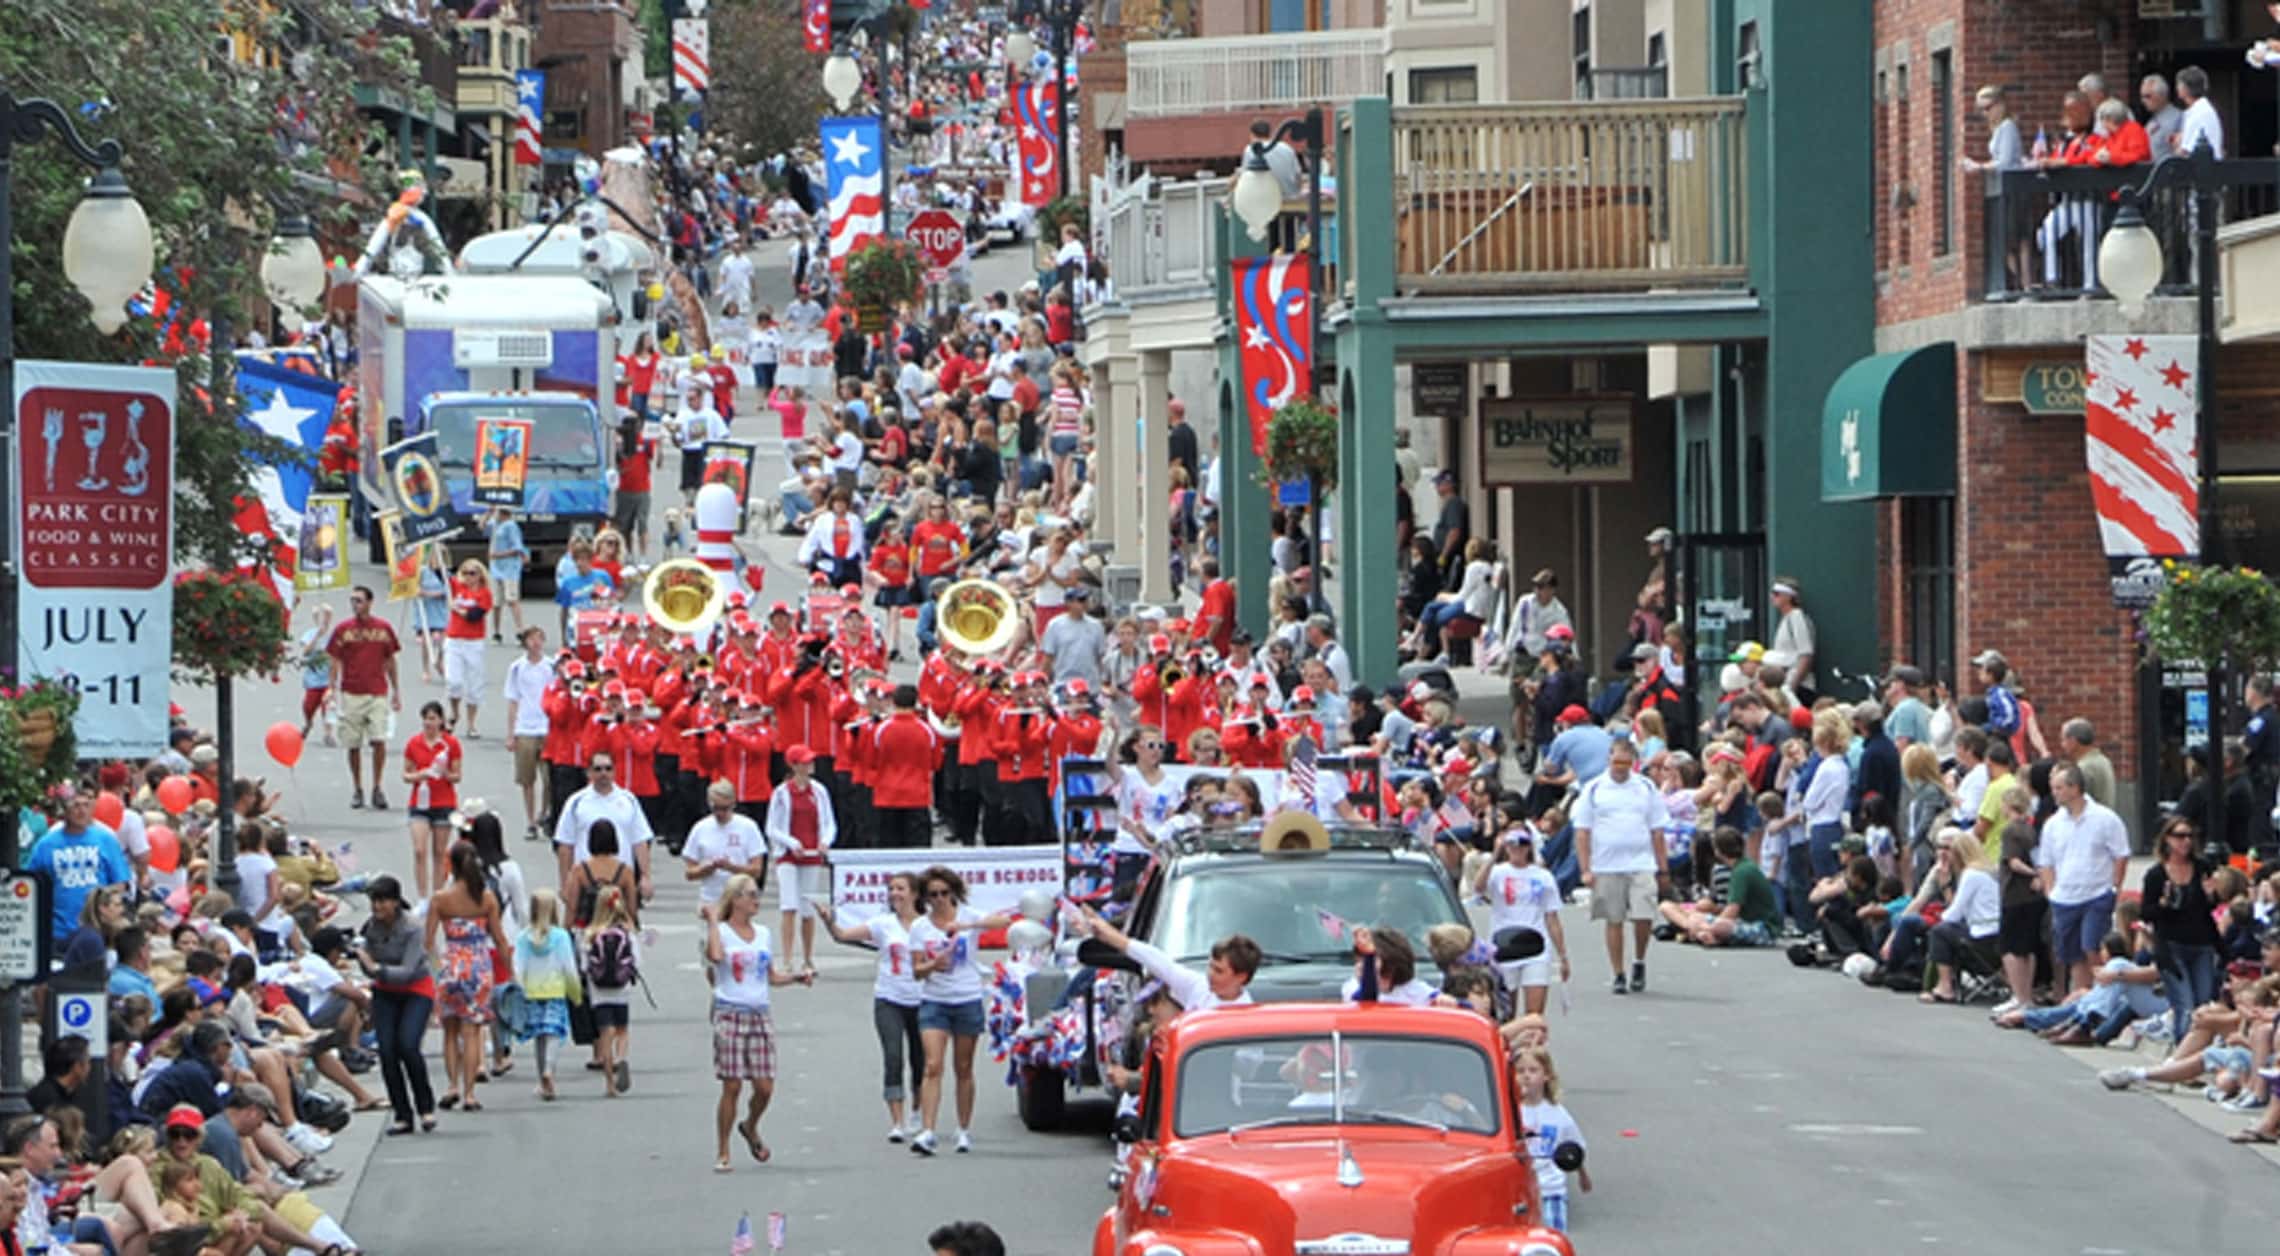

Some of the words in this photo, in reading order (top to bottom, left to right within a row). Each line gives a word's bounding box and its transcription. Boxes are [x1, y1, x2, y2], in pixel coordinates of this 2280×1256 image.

[910, 226, 960, 251] STOP
[27, 503, 89, 521] PARK
[100, 505, 159, 524] CITY
[27, 530, 80, 545] FOOD
[89, 531, 101, 545] &
[109, 532, 159, 546] WINE
[28, 551, 159, 568] CLASSIC
[43, 607, 147, 651] JULY
[994, 868, 1058, 884] SCHOOL
